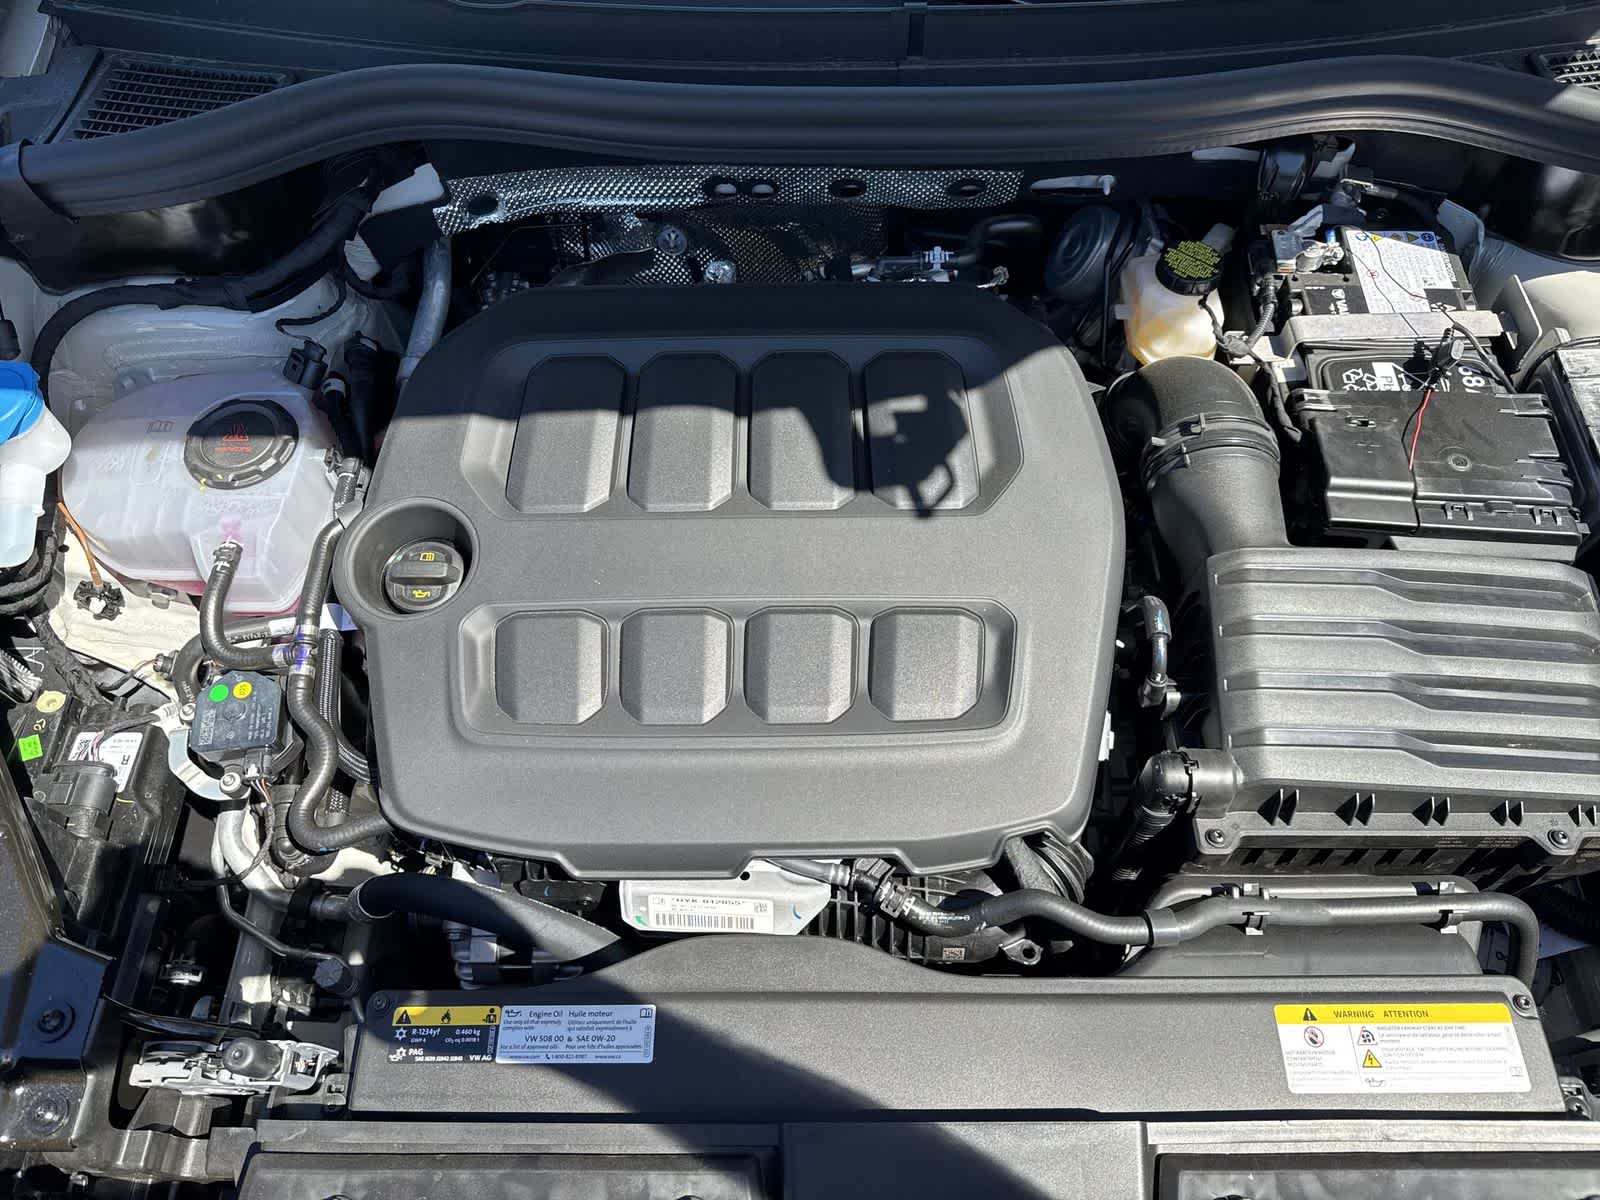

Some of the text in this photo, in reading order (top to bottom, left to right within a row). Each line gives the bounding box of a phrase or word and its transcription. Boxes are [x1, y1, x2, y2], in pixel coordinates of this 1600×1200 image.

[529, 1010, 613, 1020] Engine Oil Huile moteur
[1333, 1010, 1430, 1019] WARNING ATTENTION
[411, 1028, 441, 1037] R-1234yf
[473, 1028, 481, 1036] kg
[408, 1048, 424, 1056] PAG
